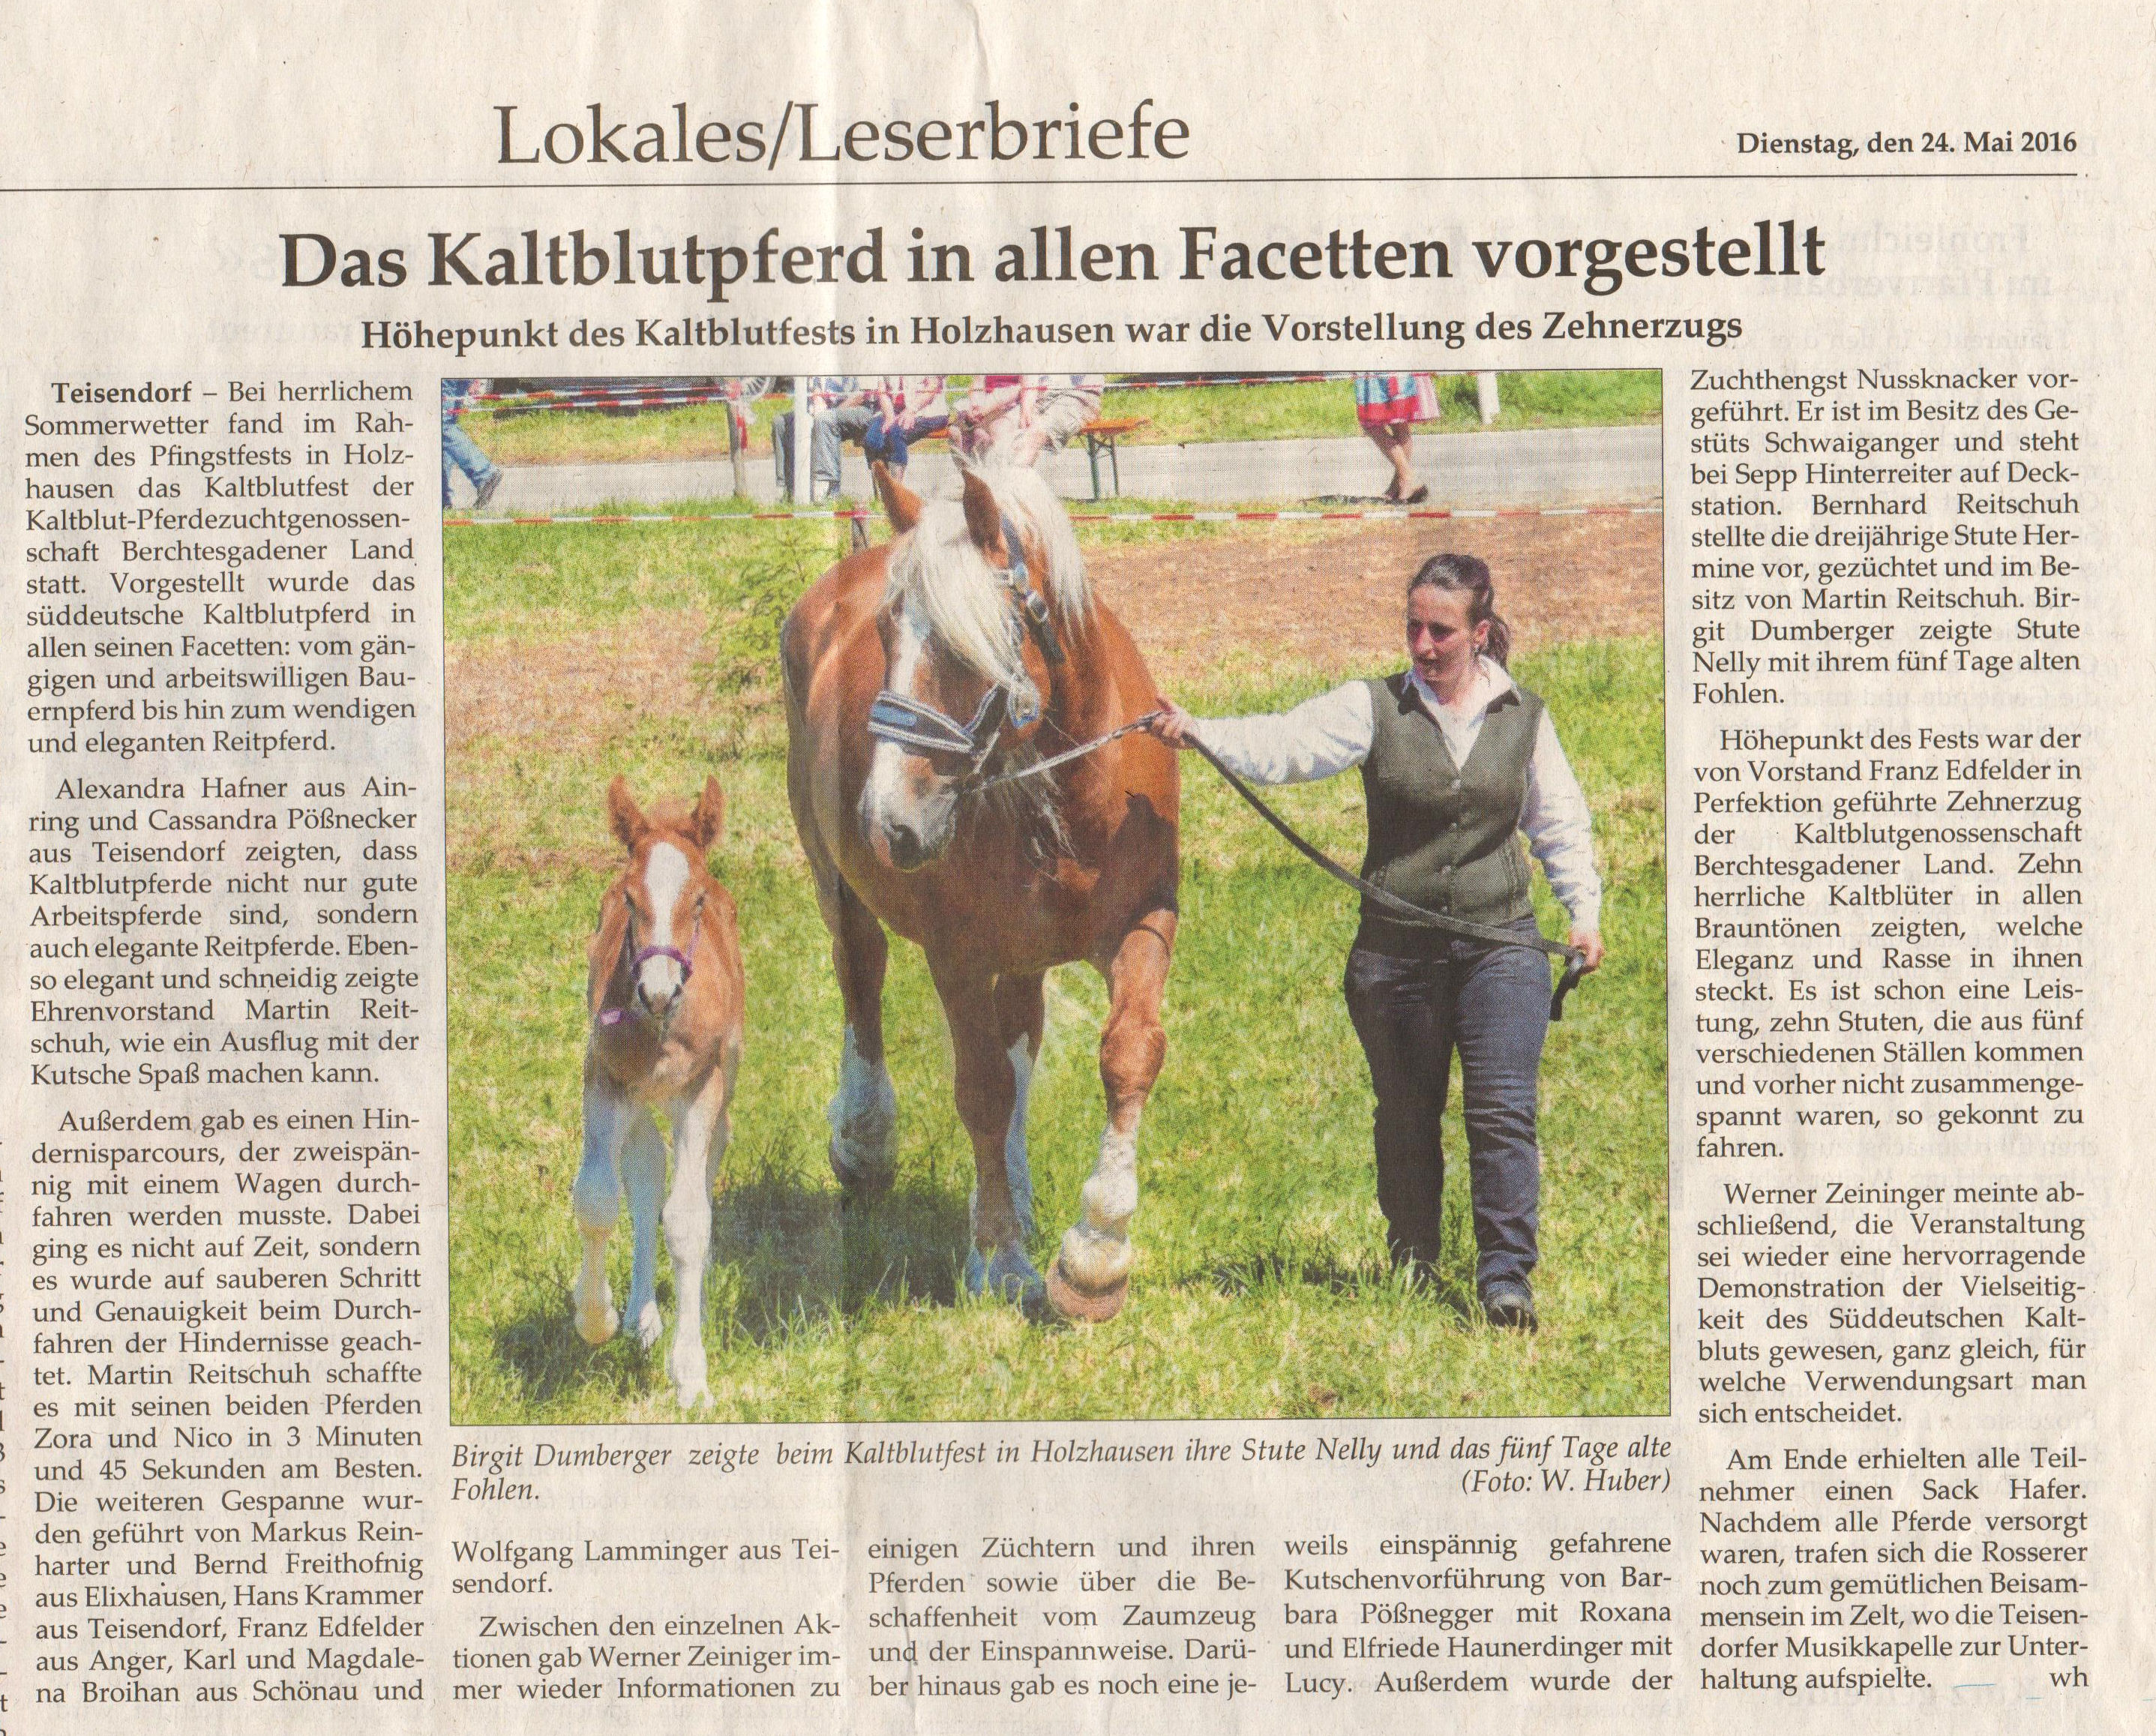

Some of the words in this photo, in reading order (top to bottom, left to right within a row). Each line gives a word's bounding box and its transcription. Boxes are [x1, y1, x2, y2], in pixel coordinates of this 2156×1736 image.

[493, 97, 1189, 171] Lokales/Leserbriefe
[1736, 131, 1860, 160] Dienstag,
[1867, 130, 1915, 154] den
[1921, 131, 1955, 153] 24.
[1963, 130, 2014, 153] Mai
[2020, 131, 2077, 153] 2016
[278, 233, 407, 288] Das
[427, 226, 888, 304] Kaltblutpferd
[907, 226, 975, 282] in
[994, 224, 1160, 283] allen
[1179, 226, 1453, 280] Facetten
[1471, 219, 1826, 297] vorgestellt
[361, 319, 559, 358] Höhepunkt
[568, 318, 625, 347] des
[635, 316, 856, 346] Kaltblutfests
[865, 316, 900, 345] in
[910, 315, 1115, 345] Holzhausen
[1124, 322, 1190, 343] war
[1200, 313, 1252, 343] die
[1261, 311, 1465, 350] Vorstellung
[1475, 310, 1532, 340] des
[1542, 310, 1743, 348] Zehnerzugs
[50, 380, 193, 404] Teisendorf
[227, 381, 266, 402] Bei
[277, 379, 414, 402] herrlichem
[1690, 368, 1848, 397] Zuchthengst
[1856, 367, 2018, 390] Nussknacker
[2026, 373, 2079, 388] vor-
[25, 414, 209, 436] Sommerwetter
[228, 411, 284, 434] fand
[304, 412, 336, 433] im
[355, 411, 414, 433] Rah-
[1691, 494, 1782, 516] station.
[1811, 493, 1927, 515] Bernhard
[1957, 492, 2080, 514] Reitschuh
[26, 540, 100, 562] schaft
[121, 538, 328, 568] Berchtesgadener
[349, 538, 414, 559] Land
[1692, 620, 1726, 649] git
[1750, 618, 1895, 648] Dumberger
[1919, 619, 1993, 647] zeigte
[2017, 617, 2080, 640] Stute
[27, 668, 97, 697] gigen
[105, 667, 156, 689] und
[166, 665, 349, 695] arbeitswilligen
[358, 665, 416, 687] Bau-
[1693, 766, 1741, 782] von
[1747, 759, 1863, 782] Vorstand
[1869, 760, 1939, 781] Franz
[1945, 758, 2052, 781] Edfelder
[2057, 758, 2083, 780] in
[28, 811, 80, 839] ring
[88, 808, 138, 832] und
[148, 808, 278, 831] Cassandra
[287, 807, 417, 829] Pößnecker
[1693, 884, 1805, 907] herrliche
[1828, 883, 1954, 907] Kaltblüter
[1976, 884, 2001, 905] in
[2023, 883, 2083, 905] allen
[30, 936, 90, 958] auch
[94, 935, 199, 965] elegante
[204, 934, 340, 964] Reitpferde.
[346, 934, 418, 956] Eben-
[1696, 1014, 1760, 1040] tung,
[1769, 1010, 1831, 1033] zehn
[1838, 1010, 1924, 1035] Stuten,
[1933, 1009, 1972, 1031] die
[1981, 1015, 2023, 1031] aus
[2032, 1008, 2084, 1030] fünf
[31, 1063, 131, 1086] Kutsche
[139, 1062, 199, 1092] Spaß
[207, 1061, 304, 1084] machen
[310, 1061, 379, 1083] kann.
[1696, 1135, 1784, 1158] fahren.
[31, 1205, 112, 1227] fahren
[127, 1204, 223, 1226] werden
[238, 1206, 331, 1225] musste.
[347, 1203, 421, 1225] Dabei
[1697, 1276, 1885, 1299] Demonstration
[1903, 1275, 1943, 1297] der
[1960, 1274, 2086, 1304] Vielseitig-
[33, 1332, 114, 1354] fahren
[125, 1331, 167, 1354] der
[178, 1330, 329, 1353] Hindernisse
[340, 1329, 421, 1359] geach-
[1699, 1401, 1748, 1423] sich
[1755, 1400, 1902, 1423] entscheidet.
[34, 1459, 85, 1481] und
[99, 1459, 127, 1480] 45
[142, 1457, 266, 1480] Sekunden
[281, 1463, 319, 1479] am
[334, 1457, 422, 1479] Besten.
[451, 1444, 523, 1475] Birgit
[533, 1442, 672, 1474] Dumberger
[688, 1442, 760, 1474] zeigte
[776, 1441, 833, 1465] beim
[844, 1440, 987, 1471] Kaltblutfest
[997, 1440, 1020, 1463] in
[1030, 1438, 1174, 1462] Holzhausen
[1186, 1438, 1231, 1462] ihre
[1242, 1438, 1306, 1462] Stute
[1315, 1436, 1382, 1468] Nelly
[1393, 1436, 1441, 1460] und
[1450, 1435, 1490, 1462] das
[1497, 1435, 1555, 1468] fünf
[1561, 1435, 1618, 1467] Tage
[1626, 1434, 1672, 1460] alte
[451, 1476, 539, 1501] Fohlen.
[1462, 1468, 1532, 1495] (Foto:
[1540, 1468, 1574, 1492] W.
[1583, 1468, 1671, 1494] Huber)
[451, 1540, 574, 1570] Wolfgang
[583, 1540, 729, 1568] Lamminger
[739, 1545, 781, 1561] aus
[791, 1538, 840, 1560] Tei-
[1284, 1534, 1348, 1556] weils
[1380, 1533, 1518, 1562] einspännig
[1549, 1531, 1672, 1561] gefahrene
[1699, 1549, 1785, 1568] waren,
[1794, 1541, 1869, 1564] trafen
[1877, 1540, 1926, 1564] sich
[1934, 1540, 1973, 1563] die
[1981, 1540, 2089, 1562] Rosserer
[868, 1571, 965, 1594] Pferden
[987, 1571, 1058, 1593] sowie
[1079, 1570, 1136, 1592] über
[1157, 1569, 1196, 1591] die
[1216, 1569, 1256, 1591] Be-
[35, 1592, 78, 1608] aus
[84, 1585, 226, 1610] Elixhausen,
[233, 1585, 298, 1606] Hans
[304, 1584, 424, 1606] Krammer
[1283, 1603, 1339, 1625] bara
[1360, 1601, 1494, 1631] Pößnegger
[1516, 1601, 1558, 1623] mit
[1579, 1600, 1672, 1622] Roxana
[452, 1648, 532, 1669] tionen
[538, 1645, 582, 1675] gab
[587, 1645, 681, 1668] Werner
[687, 1645, 793, 1674] Zeiniger
[798, 1645, 841, 1666] im-
[868, 1640, 919, 1666] und
[929, 1639, 970, 1662] der
[980, 1639, 1174, 1669] Einspannweise.
[1183, 1639, 1257, 1660] Darü-
[1700, 1667, 1798, 1697] haltung
[1805, 1666, 1932, 1696] aufspielte.
[2049, 1665, 2089, 1687] wh
